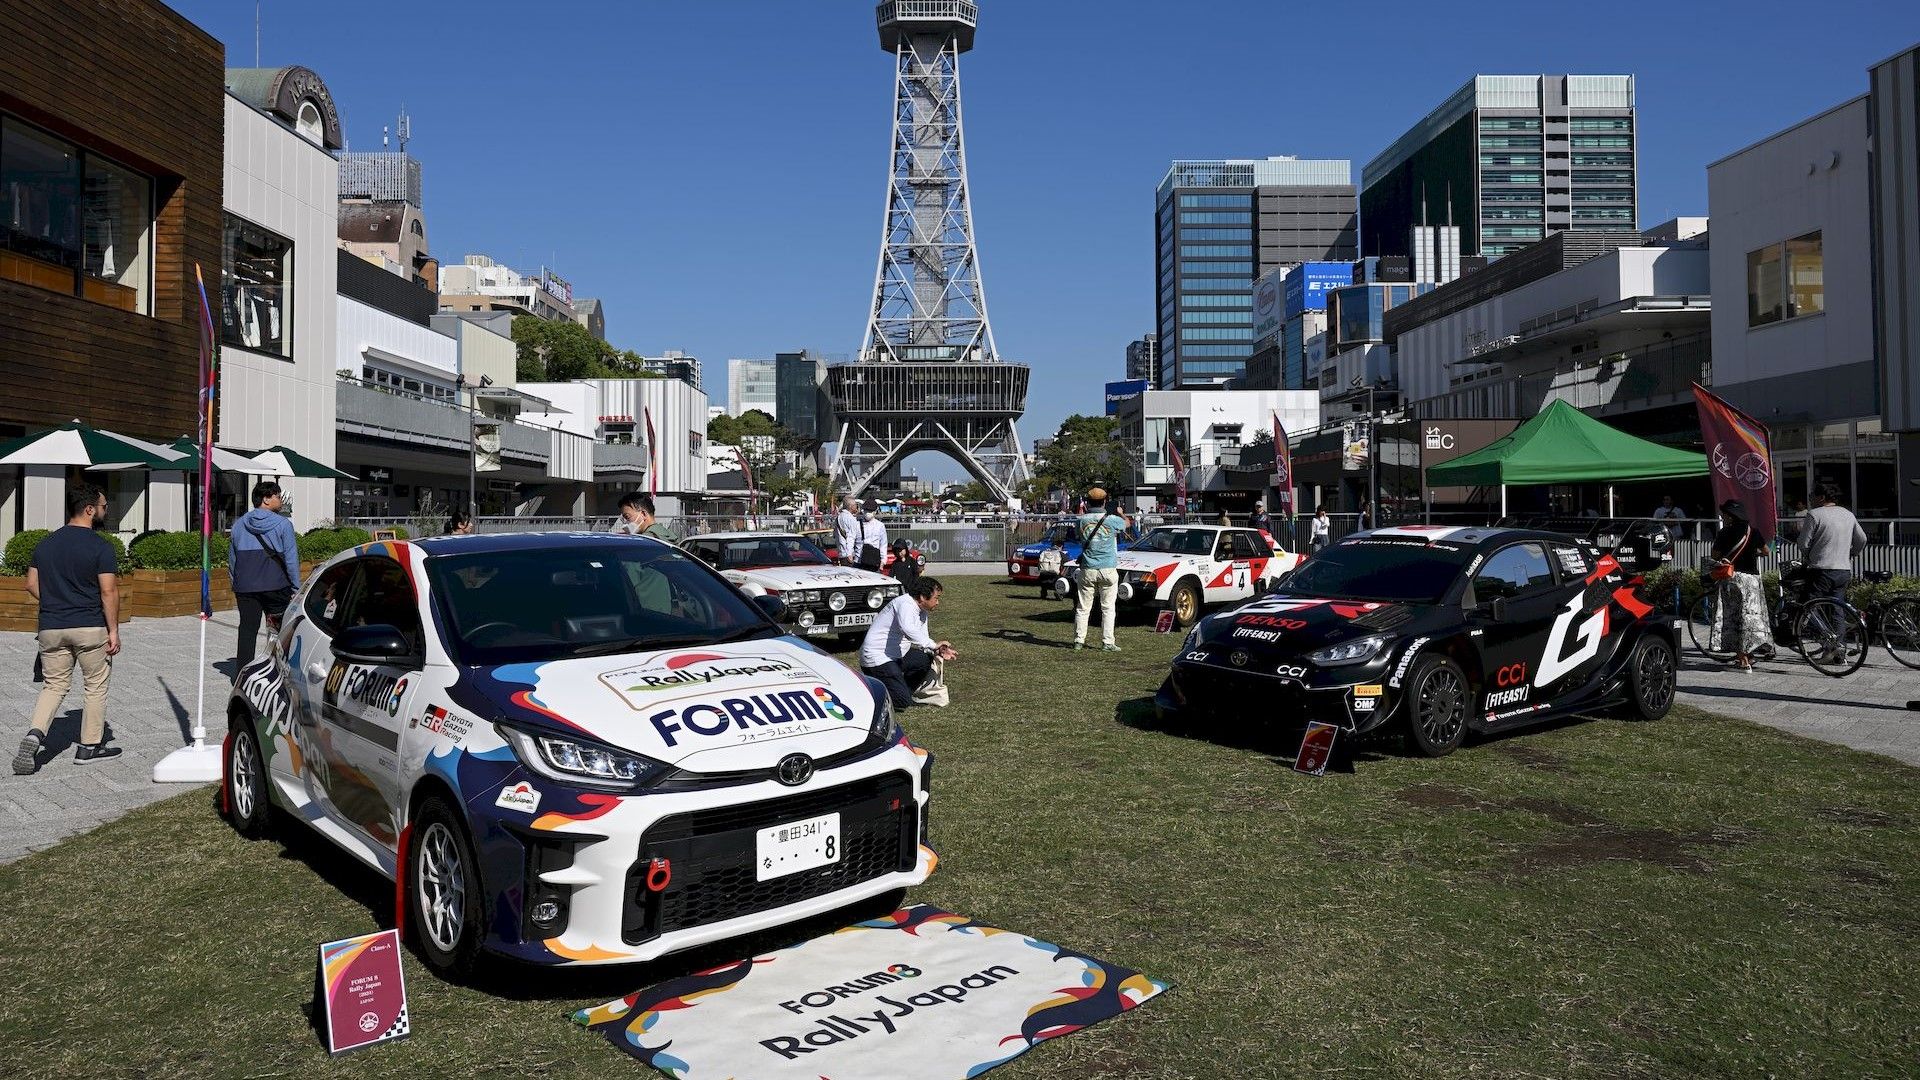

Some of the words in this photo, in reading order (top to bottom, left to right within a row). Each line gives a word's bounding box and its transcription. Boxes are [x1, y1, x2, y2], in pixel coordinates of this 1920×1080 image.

[1441, 434, 1455, 450] C
[1238, 571, 1246, 591] 4
[837, 614, 854, 626] BPA
[1235, 614, 1309, 631] DENSO
[326, 664, 345, 695] 00
[343, 665, 409, 718] FORUM8
[1354, 700, 1375, 709] OMP
[419, 713, 444, 733] GR
[447, 712, 474, 729] TOYOTA
[649, 687, 854, 748] FORUM8
[439, 727, 463, 744] Racing
[443, 721, 468, 736] GAZOO
[737, 724, 812, 743] フォーラムエイト
[802, 821, 821, 837] 341
[349, 984, 364, 994] Rally
[365, 981, 381, 990] Japan
[351, 975, 374, 986] FORUM
[373, 974, 379, 982] 8
[778, 963, 923, 1015] FORUM8
